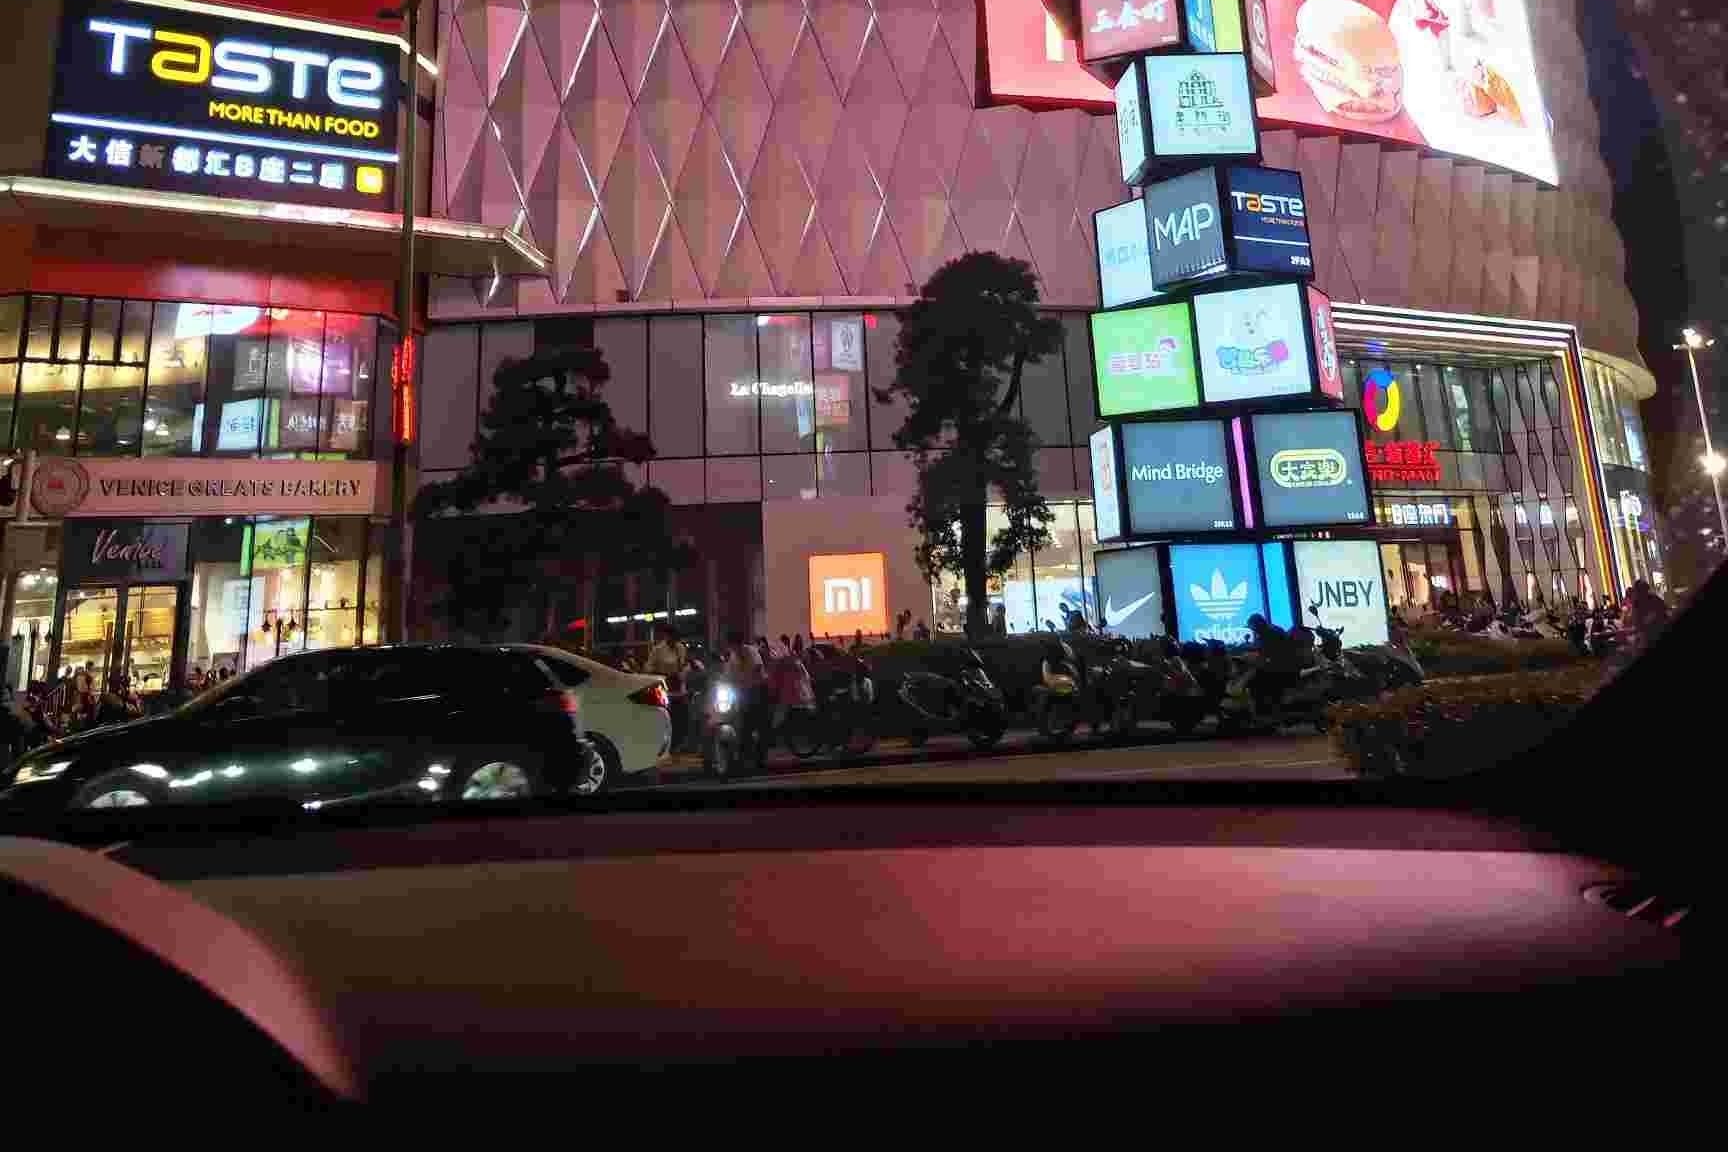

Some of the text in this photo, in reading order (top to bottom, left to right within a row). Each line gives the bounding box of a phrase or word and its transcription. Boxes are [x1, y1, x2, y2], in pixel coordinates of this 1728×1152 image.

[208, 100, 380, 139] MORE THAN FOOD
[1153, 203, 1214, 251] MAP
[1131, 461, 1225, 484] Mind Bridge
[99, 479, 182, 497] VENICE
[280, 479, 361, 497] BAKERY
[1311, 580, 1374, 609] JNBY
